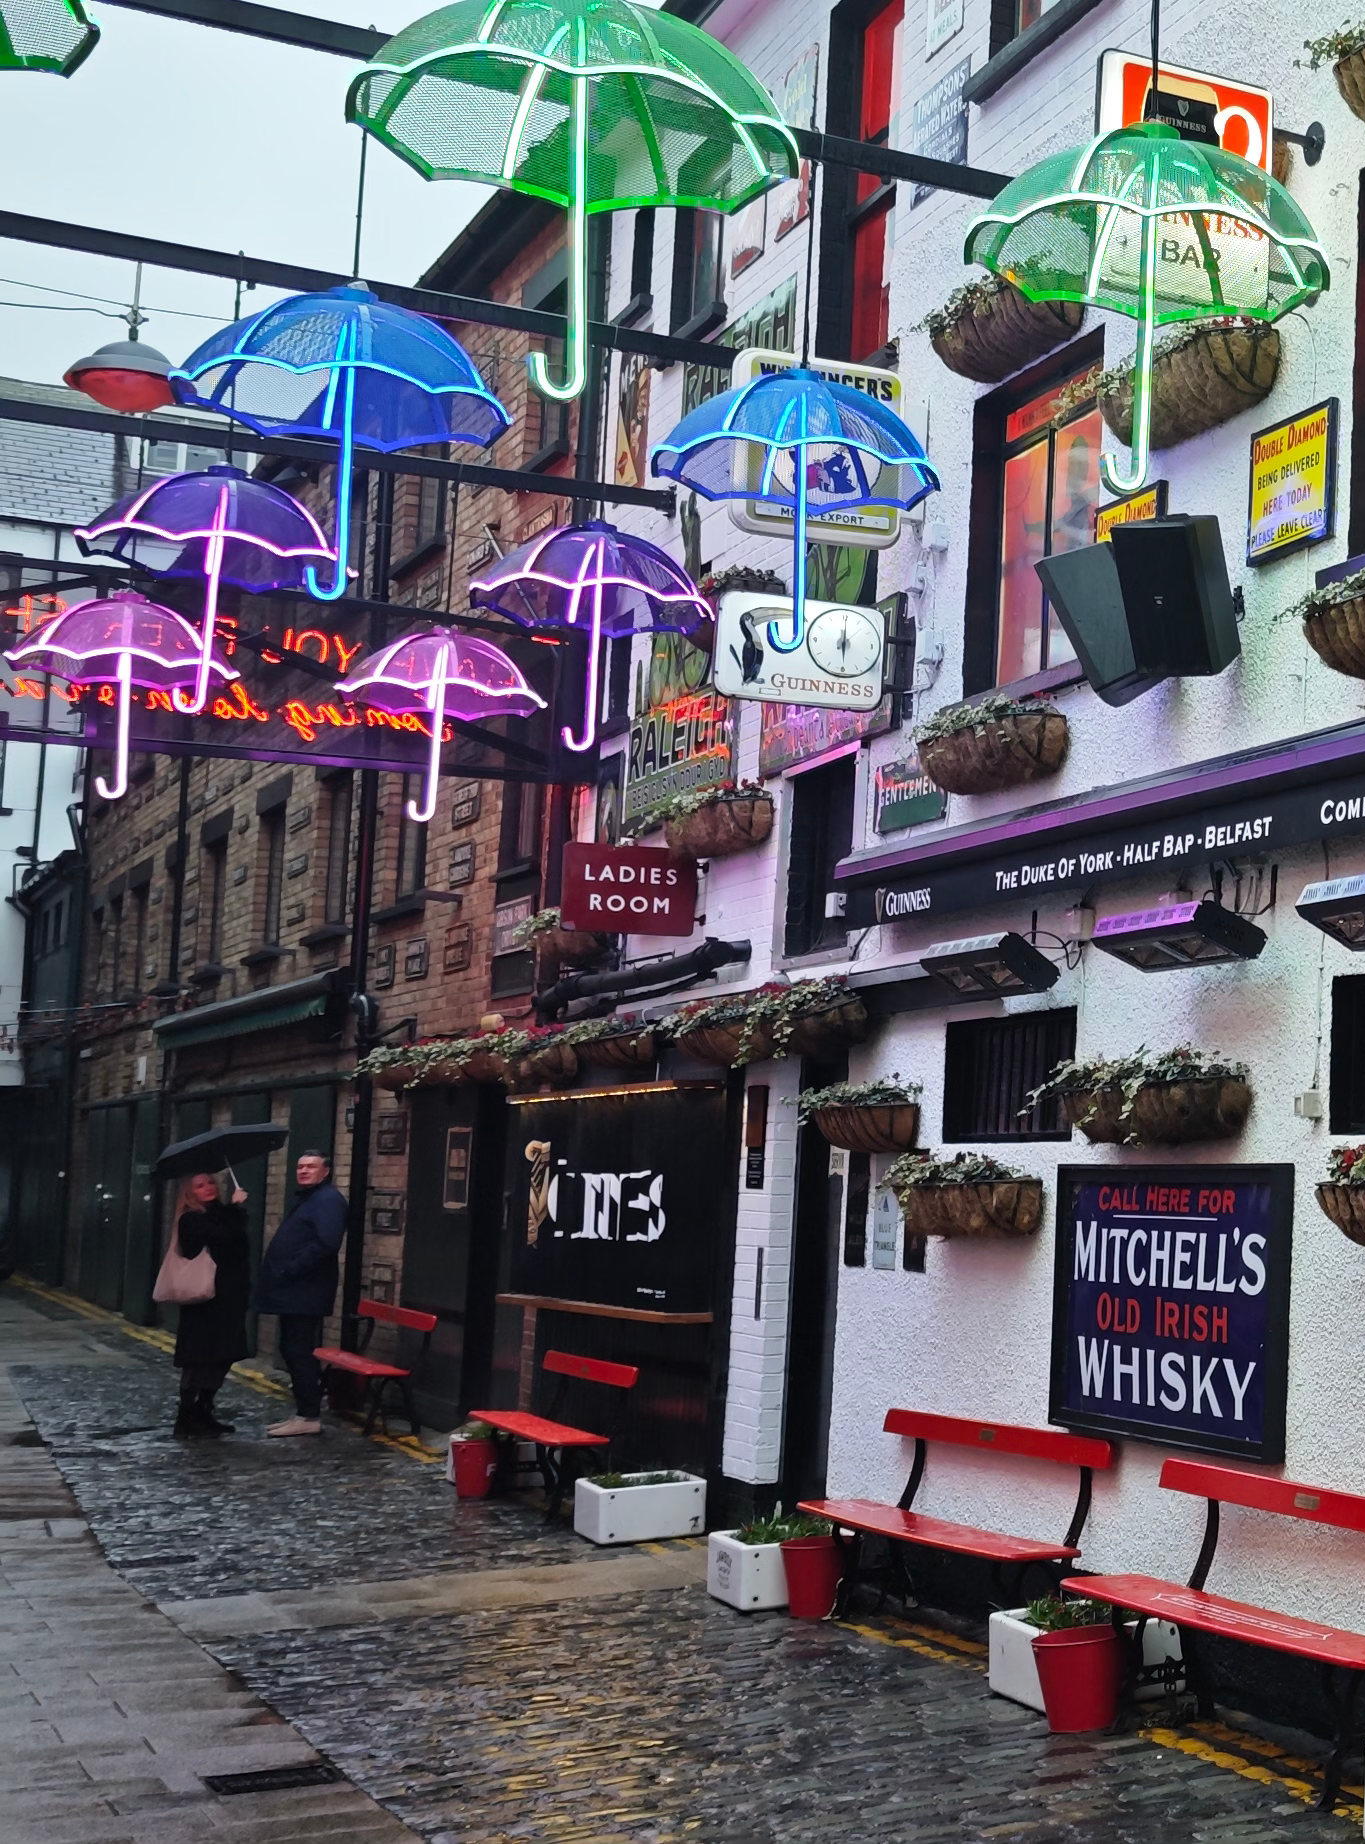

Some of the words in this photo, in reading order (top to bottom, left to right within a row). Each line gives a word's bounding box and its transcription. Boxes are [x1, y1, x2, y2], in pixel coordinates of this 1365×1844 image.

[1157, 115, 1207, 134] GUINNESS
[1254, 435, 1284, 466] DOUBLE
[1287, 417, 1326, 445] DIAMOND
[1257, 469, 1278, 490] BEING
[1280, 451, 1320, 480] DELIVERED
[1124, 498, 1156, 523] DIAMOND
[1263, 494, 1284, 518] HERE
[1286, 483, 1312, 508] TODAY
[820, 513, 864, 525] EXPORT
[1251, 527, 1275, 549] PLEASE
[1277, 518, 1299, 538] LEAVE
[1301, 509, 1323, 530] CLEAR
[771, 673, 874, 698] GUINNESS
[627, 692, 733, 786] RALEIGH
[880, 775, 937, 808] GENTLEMEN
[995, 870, 1018, 891] THE
[1021, 863, 1055, 887] DUKE
[1058, 857, 1077, 879] OF
[1079, 851, 1114, 875] YORK
[1123, 840, 1160, 866] HALF
[1162, 833, 1194, 858] BAP
[1204, 816, 1273, 850] BELFAST
[584, 863, 678, 886] LADIES
[589, 893, 670, 916] ROOM
[885, 888, 931, 917] GUINNESS
[1098, 1186, 1140, 1211] CALL
[1146, 1186, 1191, 1213] HERE
[1199, 1189, 1235, 1214] FOR
[1073, 1220, 1267, 1296] MITCHELL'S
[1096, 1292, 1141, 1333] OLD
[1155, 1297, 1228, 1343] IRISH
[1077, 1335, 1256, 1421] WHISKY
